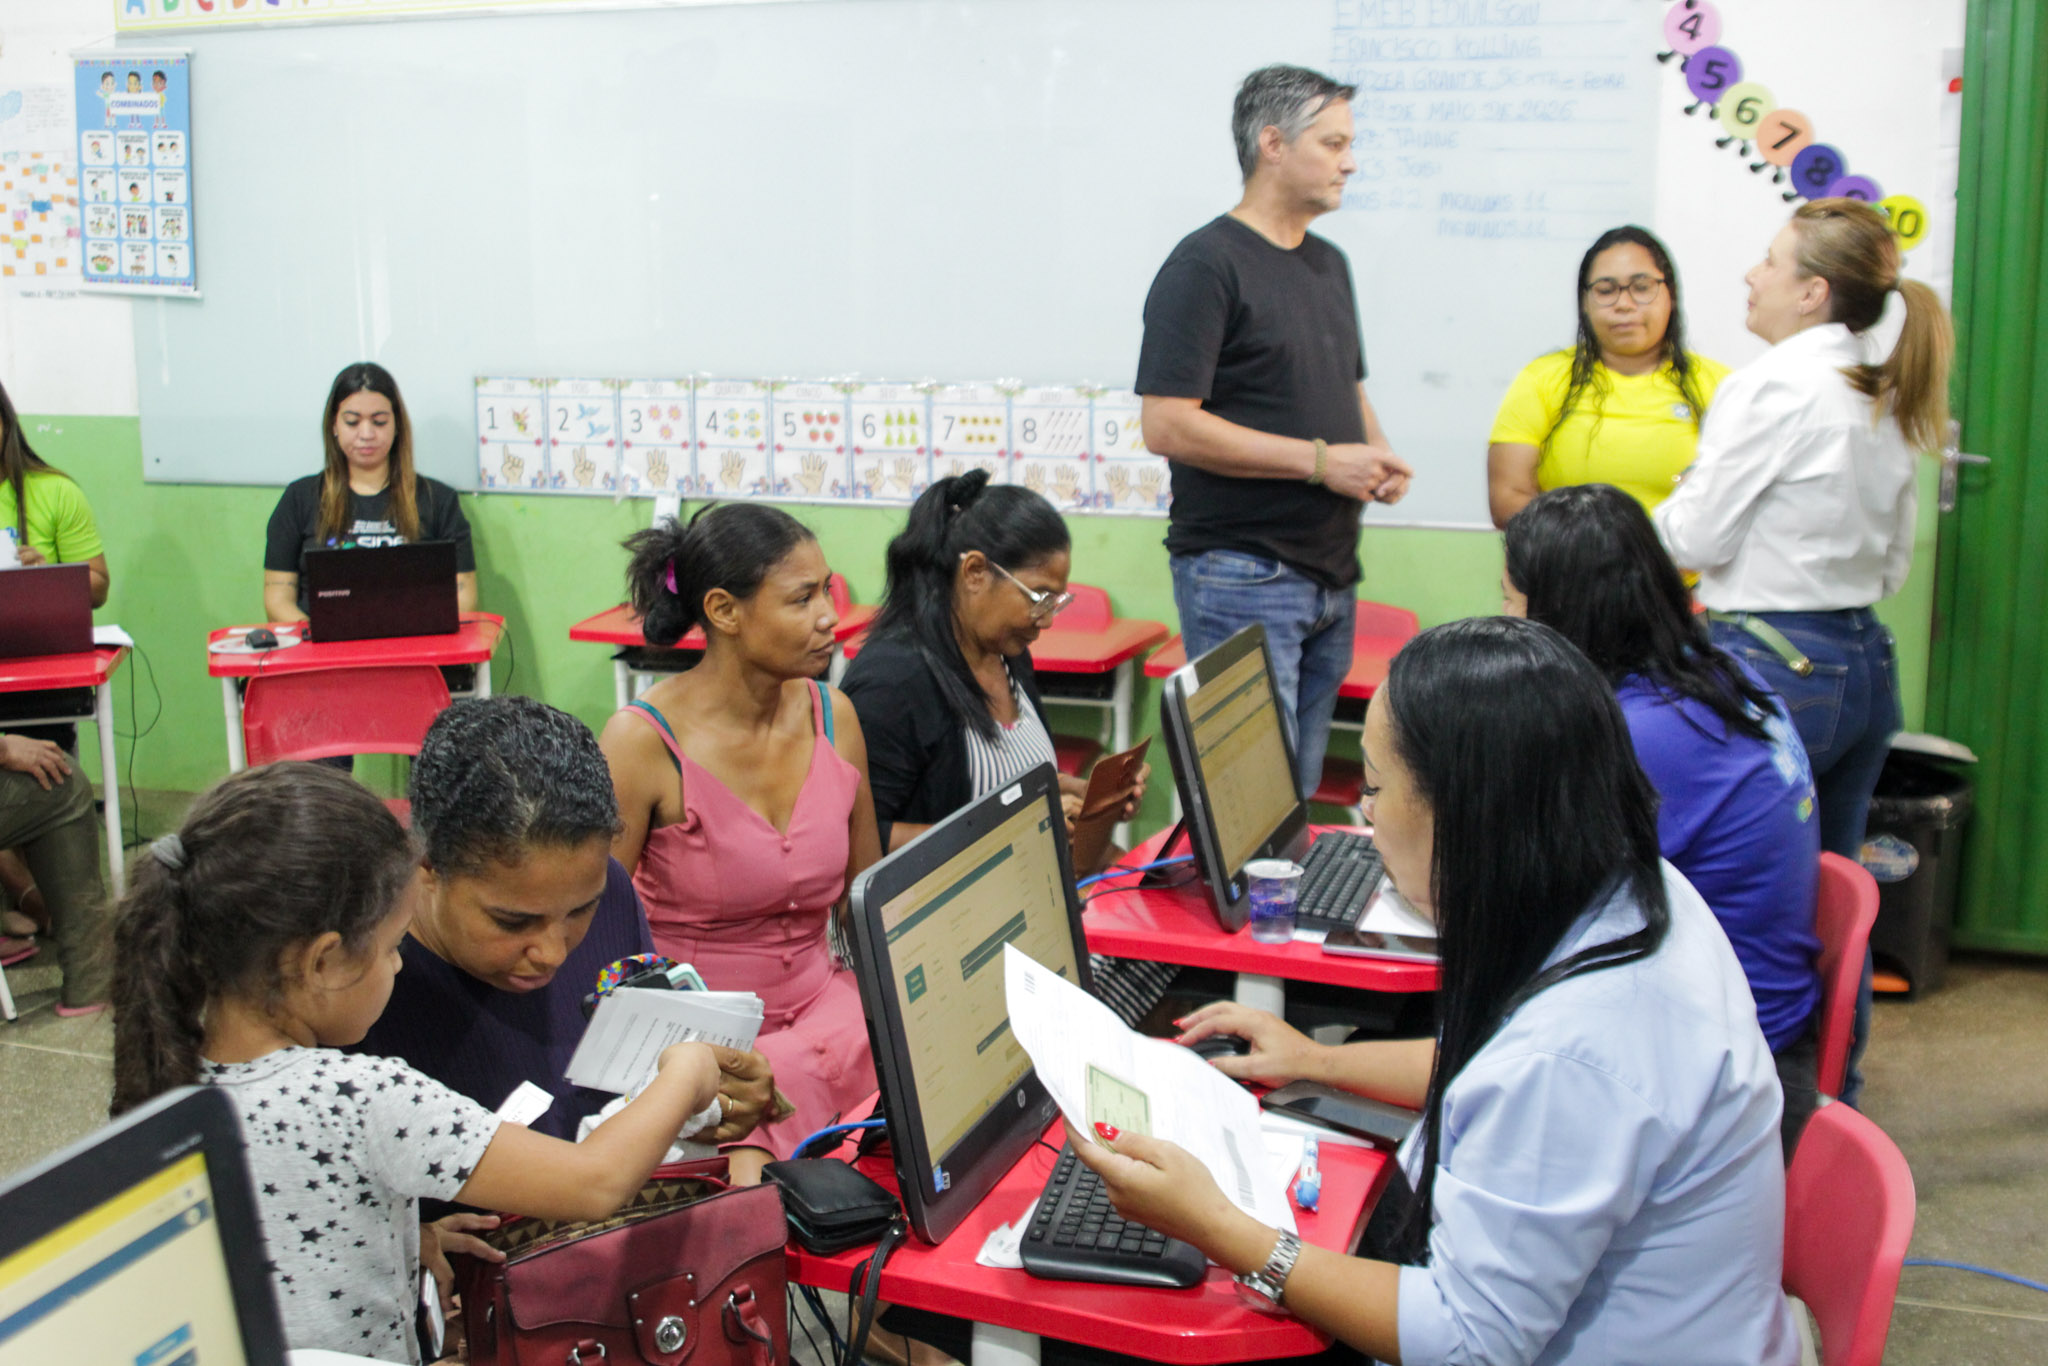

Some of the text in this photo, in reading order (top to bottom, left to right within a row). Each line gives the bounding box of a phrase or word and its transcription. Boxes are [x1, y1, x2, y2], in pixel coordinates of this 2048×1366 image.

[1679, 12, 1705, 41] 4
[1701, 59, 1728, 90] 5
[110, 100, 159, 109] COMBINADOS
[1735, 97, 1764, 125] 6
[1772, 121, 1801, 151] 7
[1805, 158, 1836, 186] 8
[487, 406, 499, 431] 1
[557, 408, 570, 432] 2
[630, 409, 643, 433] 3
[705, 410, 720, 434] 4
[783, 412, 797, 437] 5
[861, 413, 877, 439] 6
[943, 415, 956, 441] 7
[1022, 417, 1038, 443] 8
[1104, 419, 1119, 446] 9
